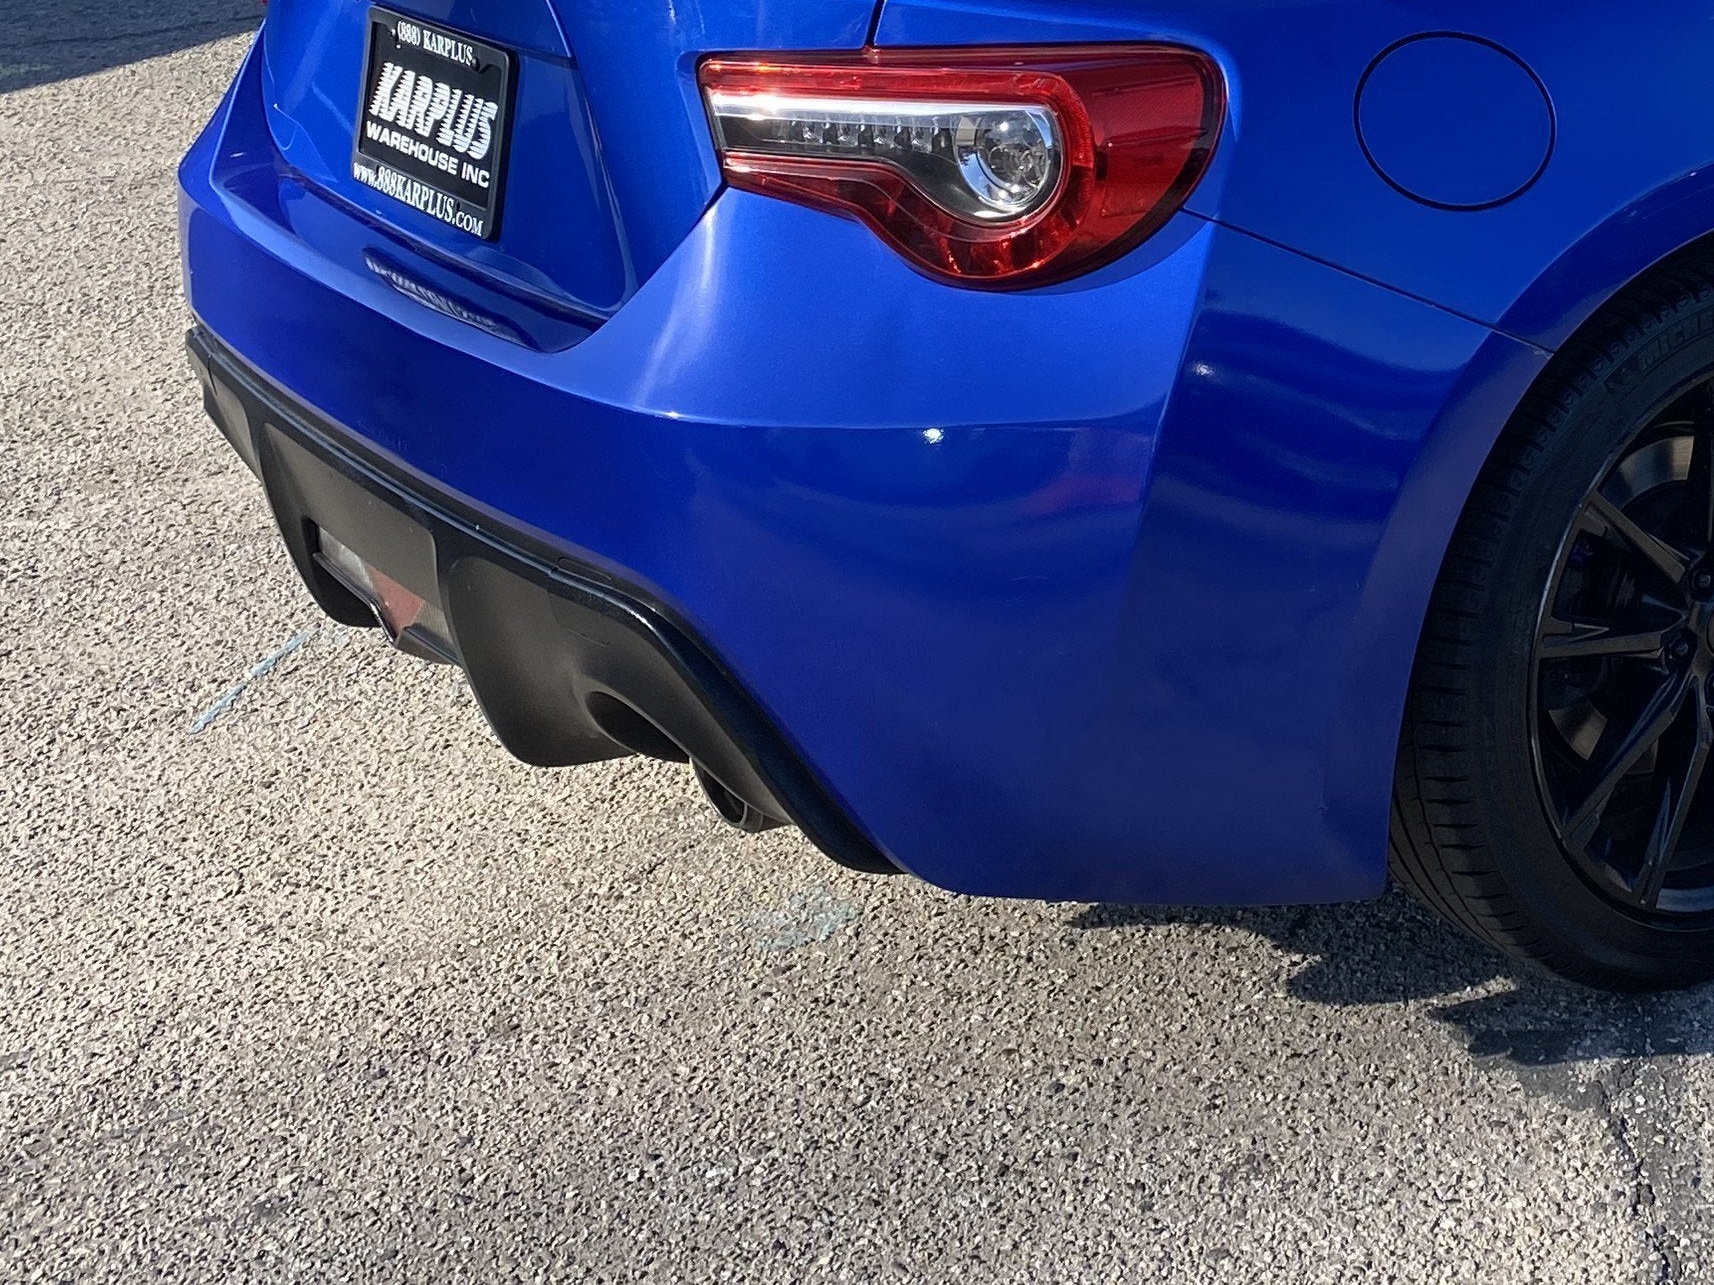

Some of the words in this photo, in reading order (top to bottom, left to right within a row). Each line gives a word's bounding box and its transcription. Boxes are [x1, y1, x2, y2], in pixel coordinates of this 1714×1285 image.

[397, 20, 421, 47] (888)
[422, 29, 473, 66] KARPLUS
[368, 61, 499, 160] KARPLUS
[366, 120, 459, 175] WAREHOUSE
[461, 161, 490, 188] INC
